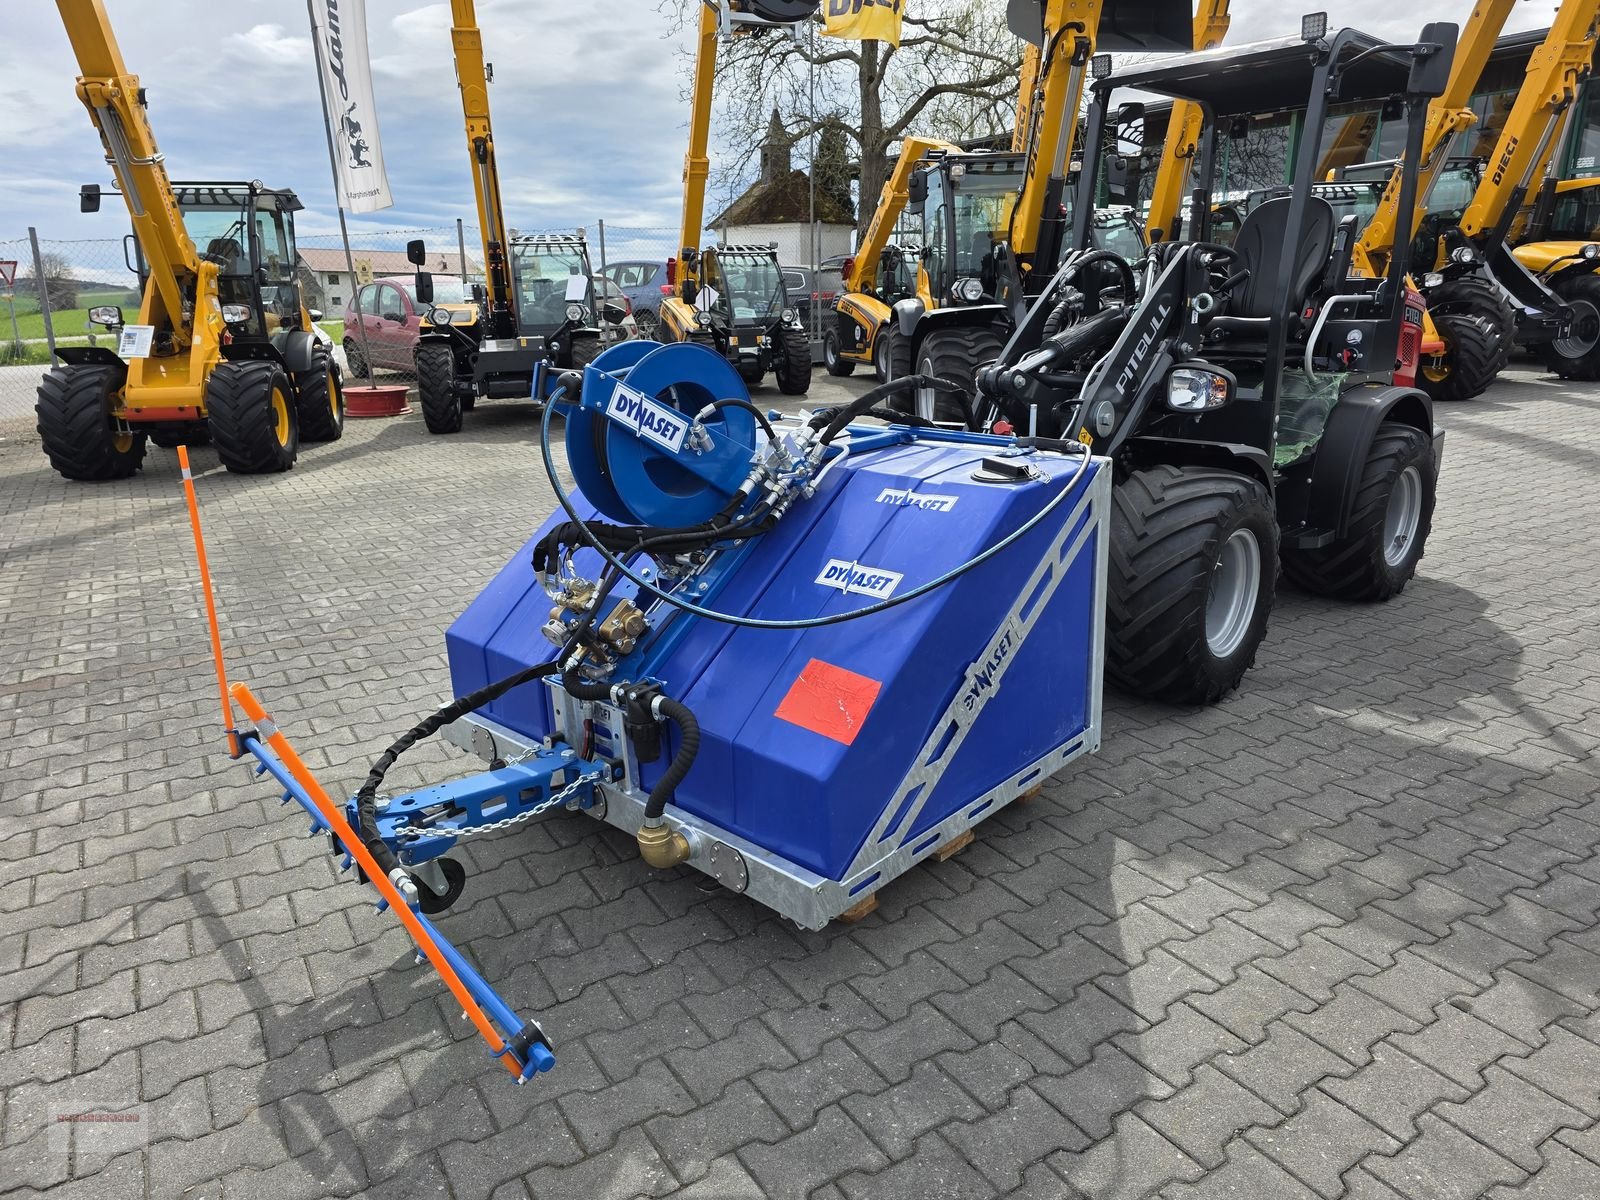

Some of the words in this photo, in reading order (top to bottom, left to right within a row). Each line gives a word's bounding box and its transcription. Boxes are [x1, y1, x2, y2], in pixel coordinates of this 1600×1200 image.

[1115, 304, 1171, 395] PITBULL
[615, 393, 680, 442] DYNASET
[824, 565, 894, 591] DYNASET
[963, 629, 1012, 711] DYNASET
